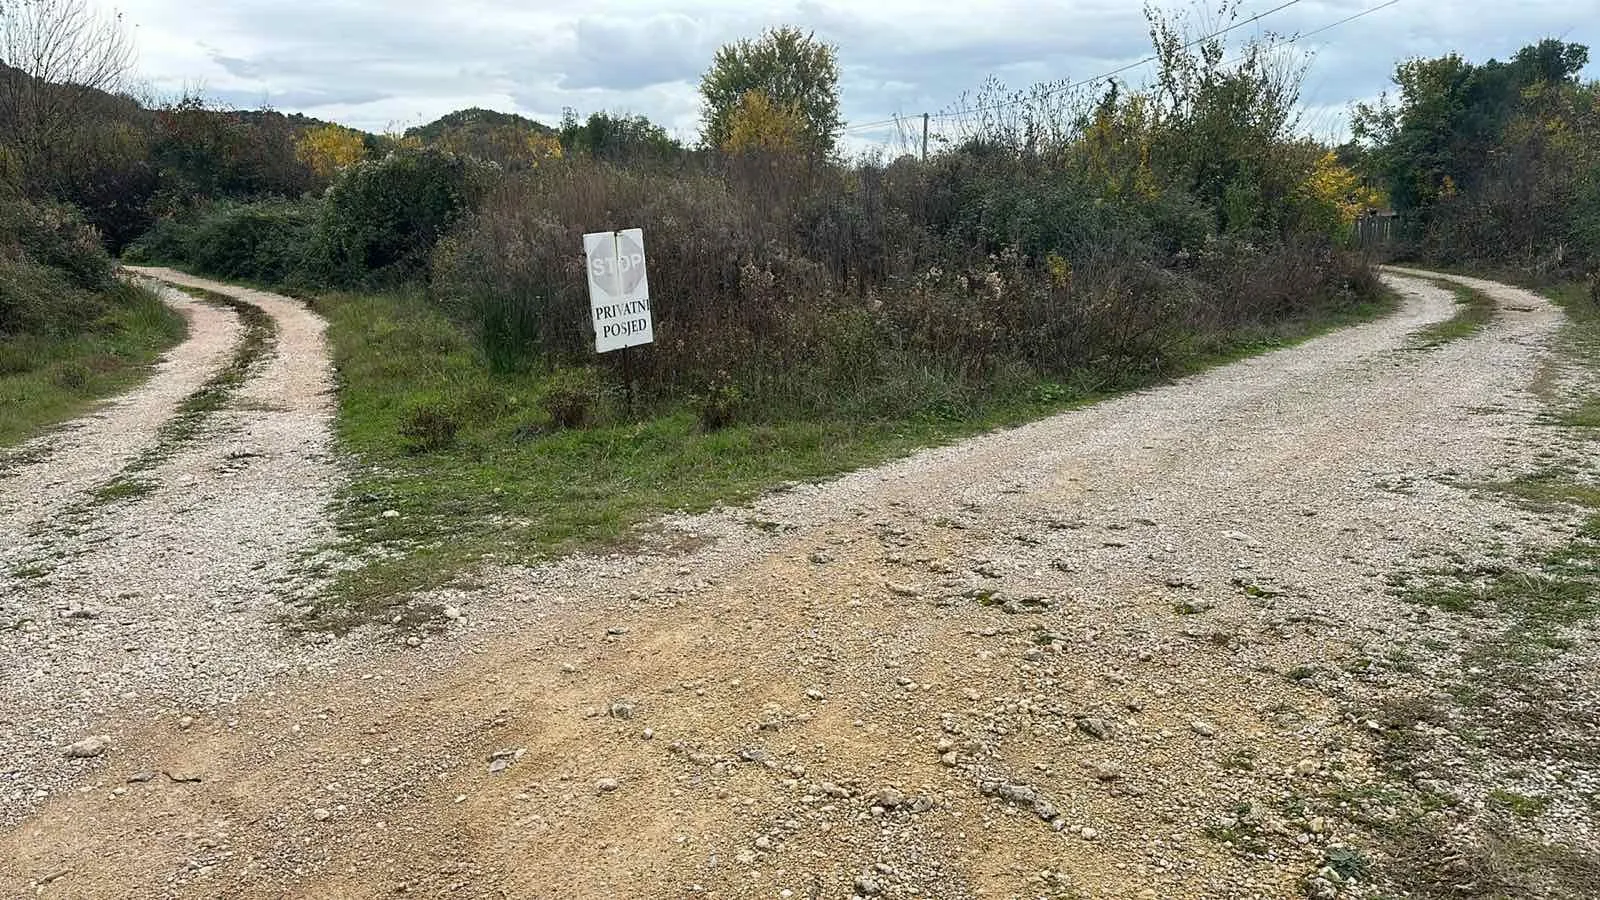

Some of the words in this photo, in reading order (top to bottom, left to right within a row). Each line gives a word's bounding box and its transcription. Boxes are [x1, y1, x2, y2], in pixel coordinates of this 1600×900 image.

[592, 253, 642, 276] STOP
[595, 299, 650, 320] PRIVATNI
[603, 318, 647, 338] POSJED
